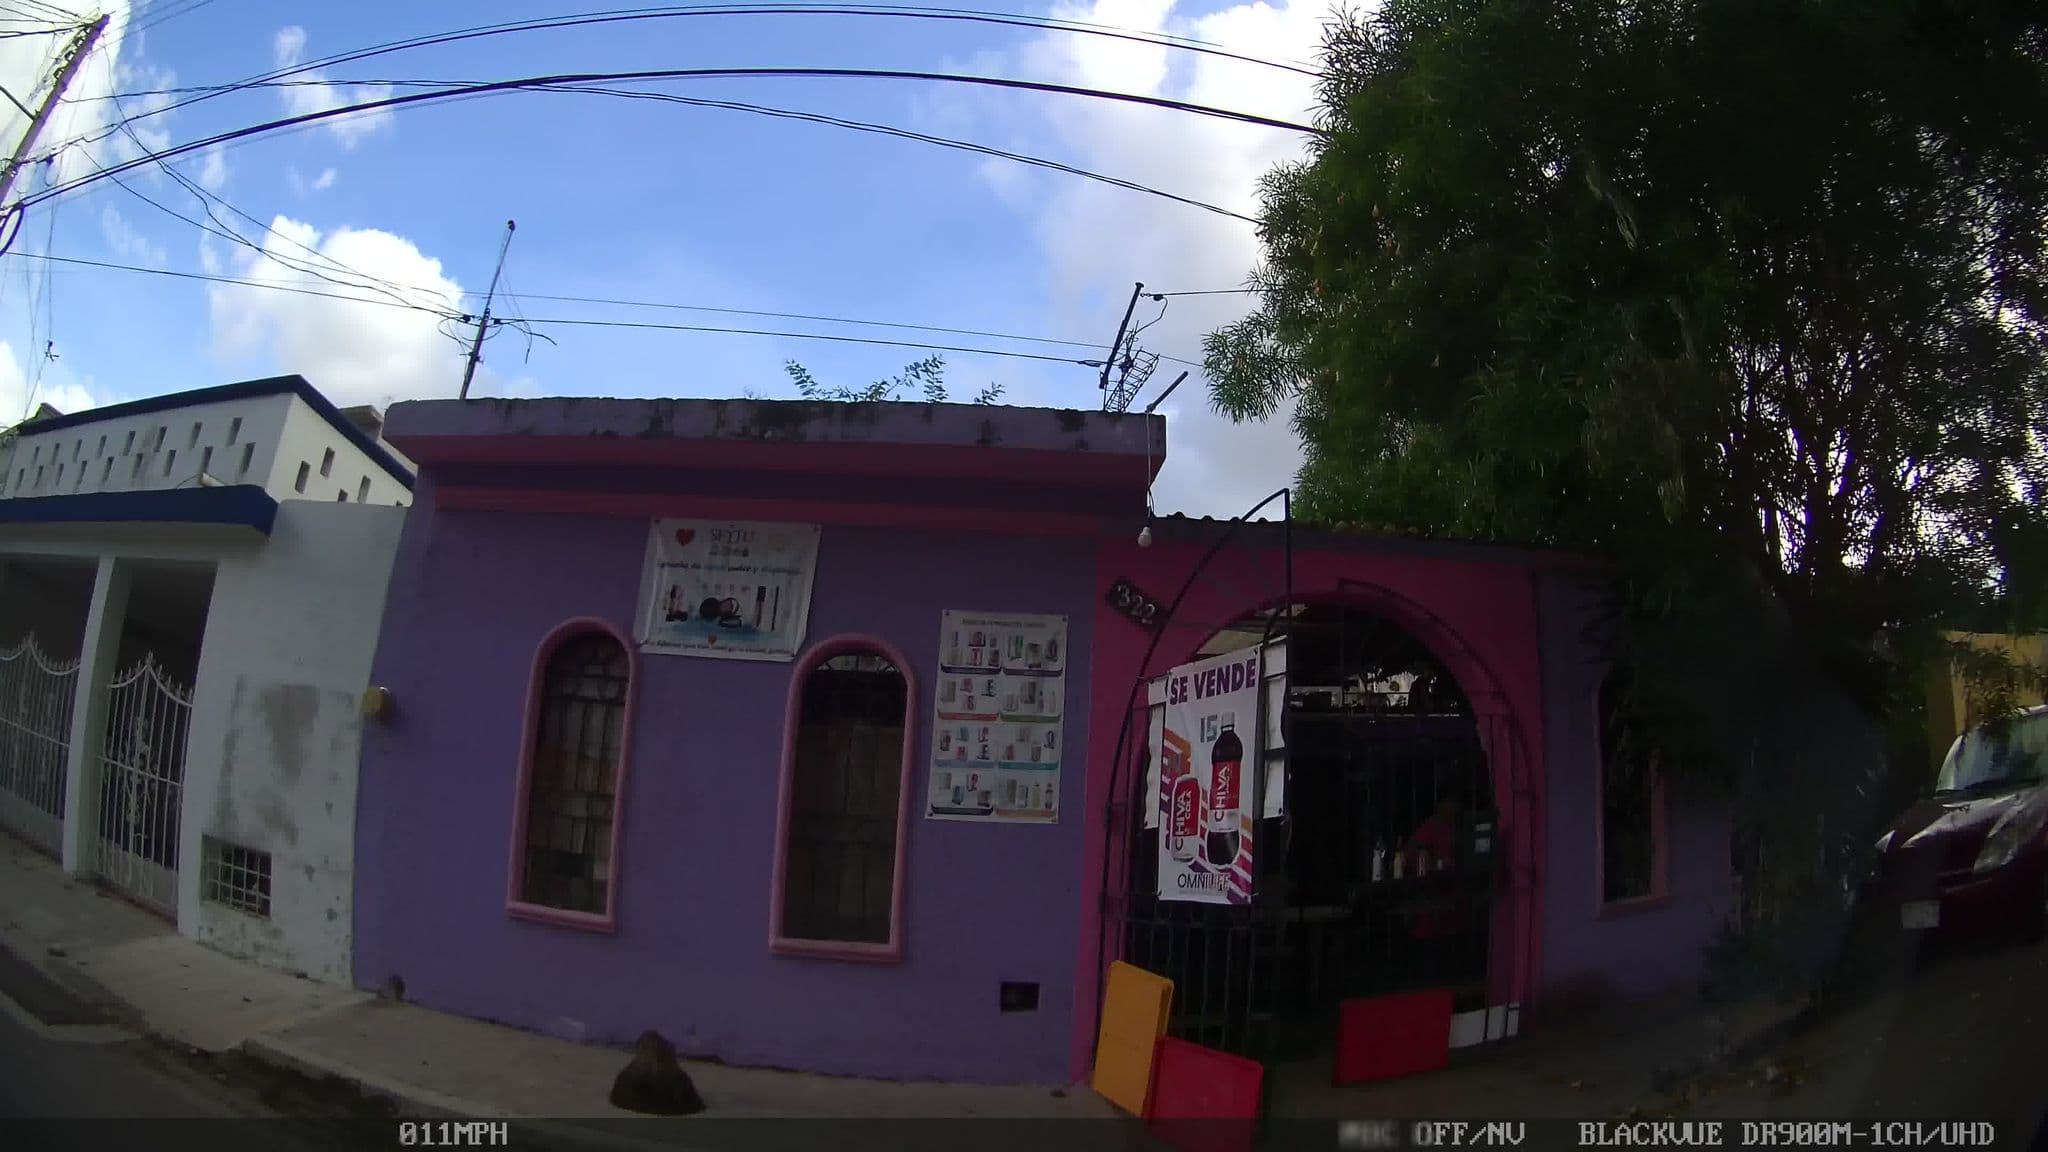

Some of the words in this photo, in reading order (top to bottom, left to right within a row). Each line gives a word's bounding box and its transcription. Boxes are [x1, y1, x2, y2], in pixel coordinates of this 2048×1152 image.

[1112, 580, 1157, 625] 322
[1169, 675, 1188, 706] SE
[1194, 658, 1257, 700] VENDE
[1184, 789, 1193, 821] COLA
[1214, 765, 1228, 823] CHIVA
[1174, 790, 1186, 850] CHIVA
